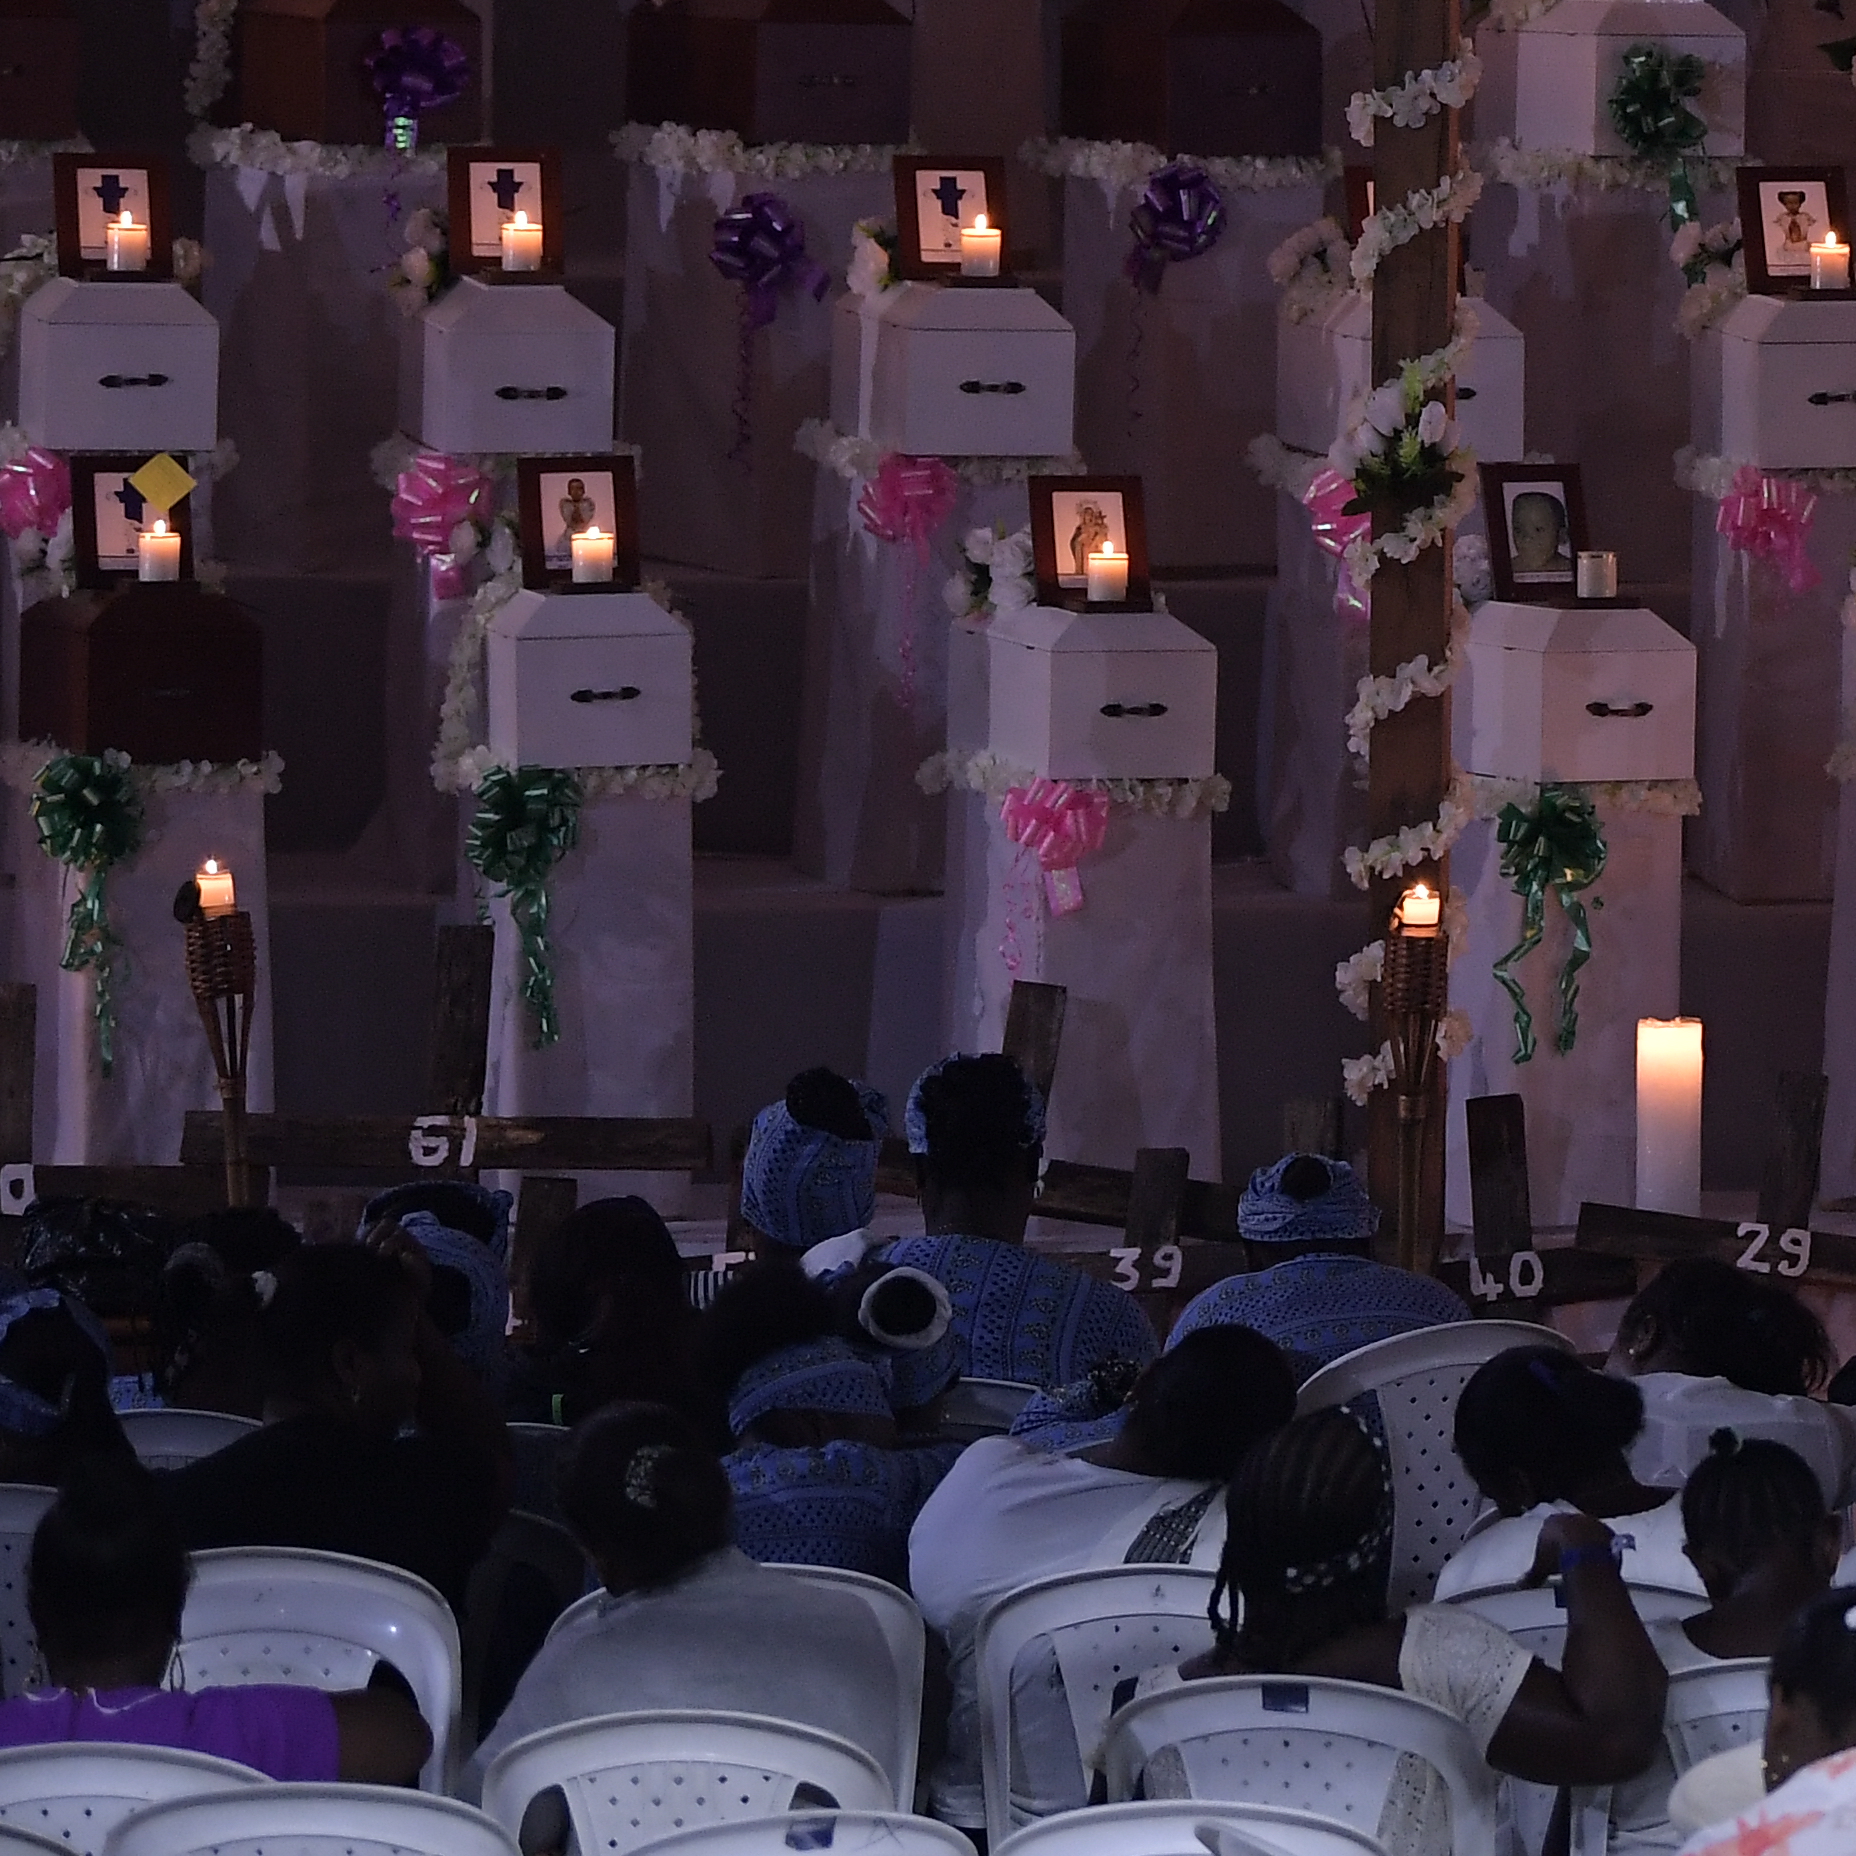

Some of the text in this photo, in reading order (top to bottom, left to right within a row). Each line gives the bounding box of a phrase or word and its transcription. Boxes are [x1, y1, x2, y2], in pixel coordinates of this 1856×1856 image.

[1109, 1245, 1183, 1292] 39
[1736, 1220, 1812, 1277] 29
[1469, 1250, 1545, 1302] 40
